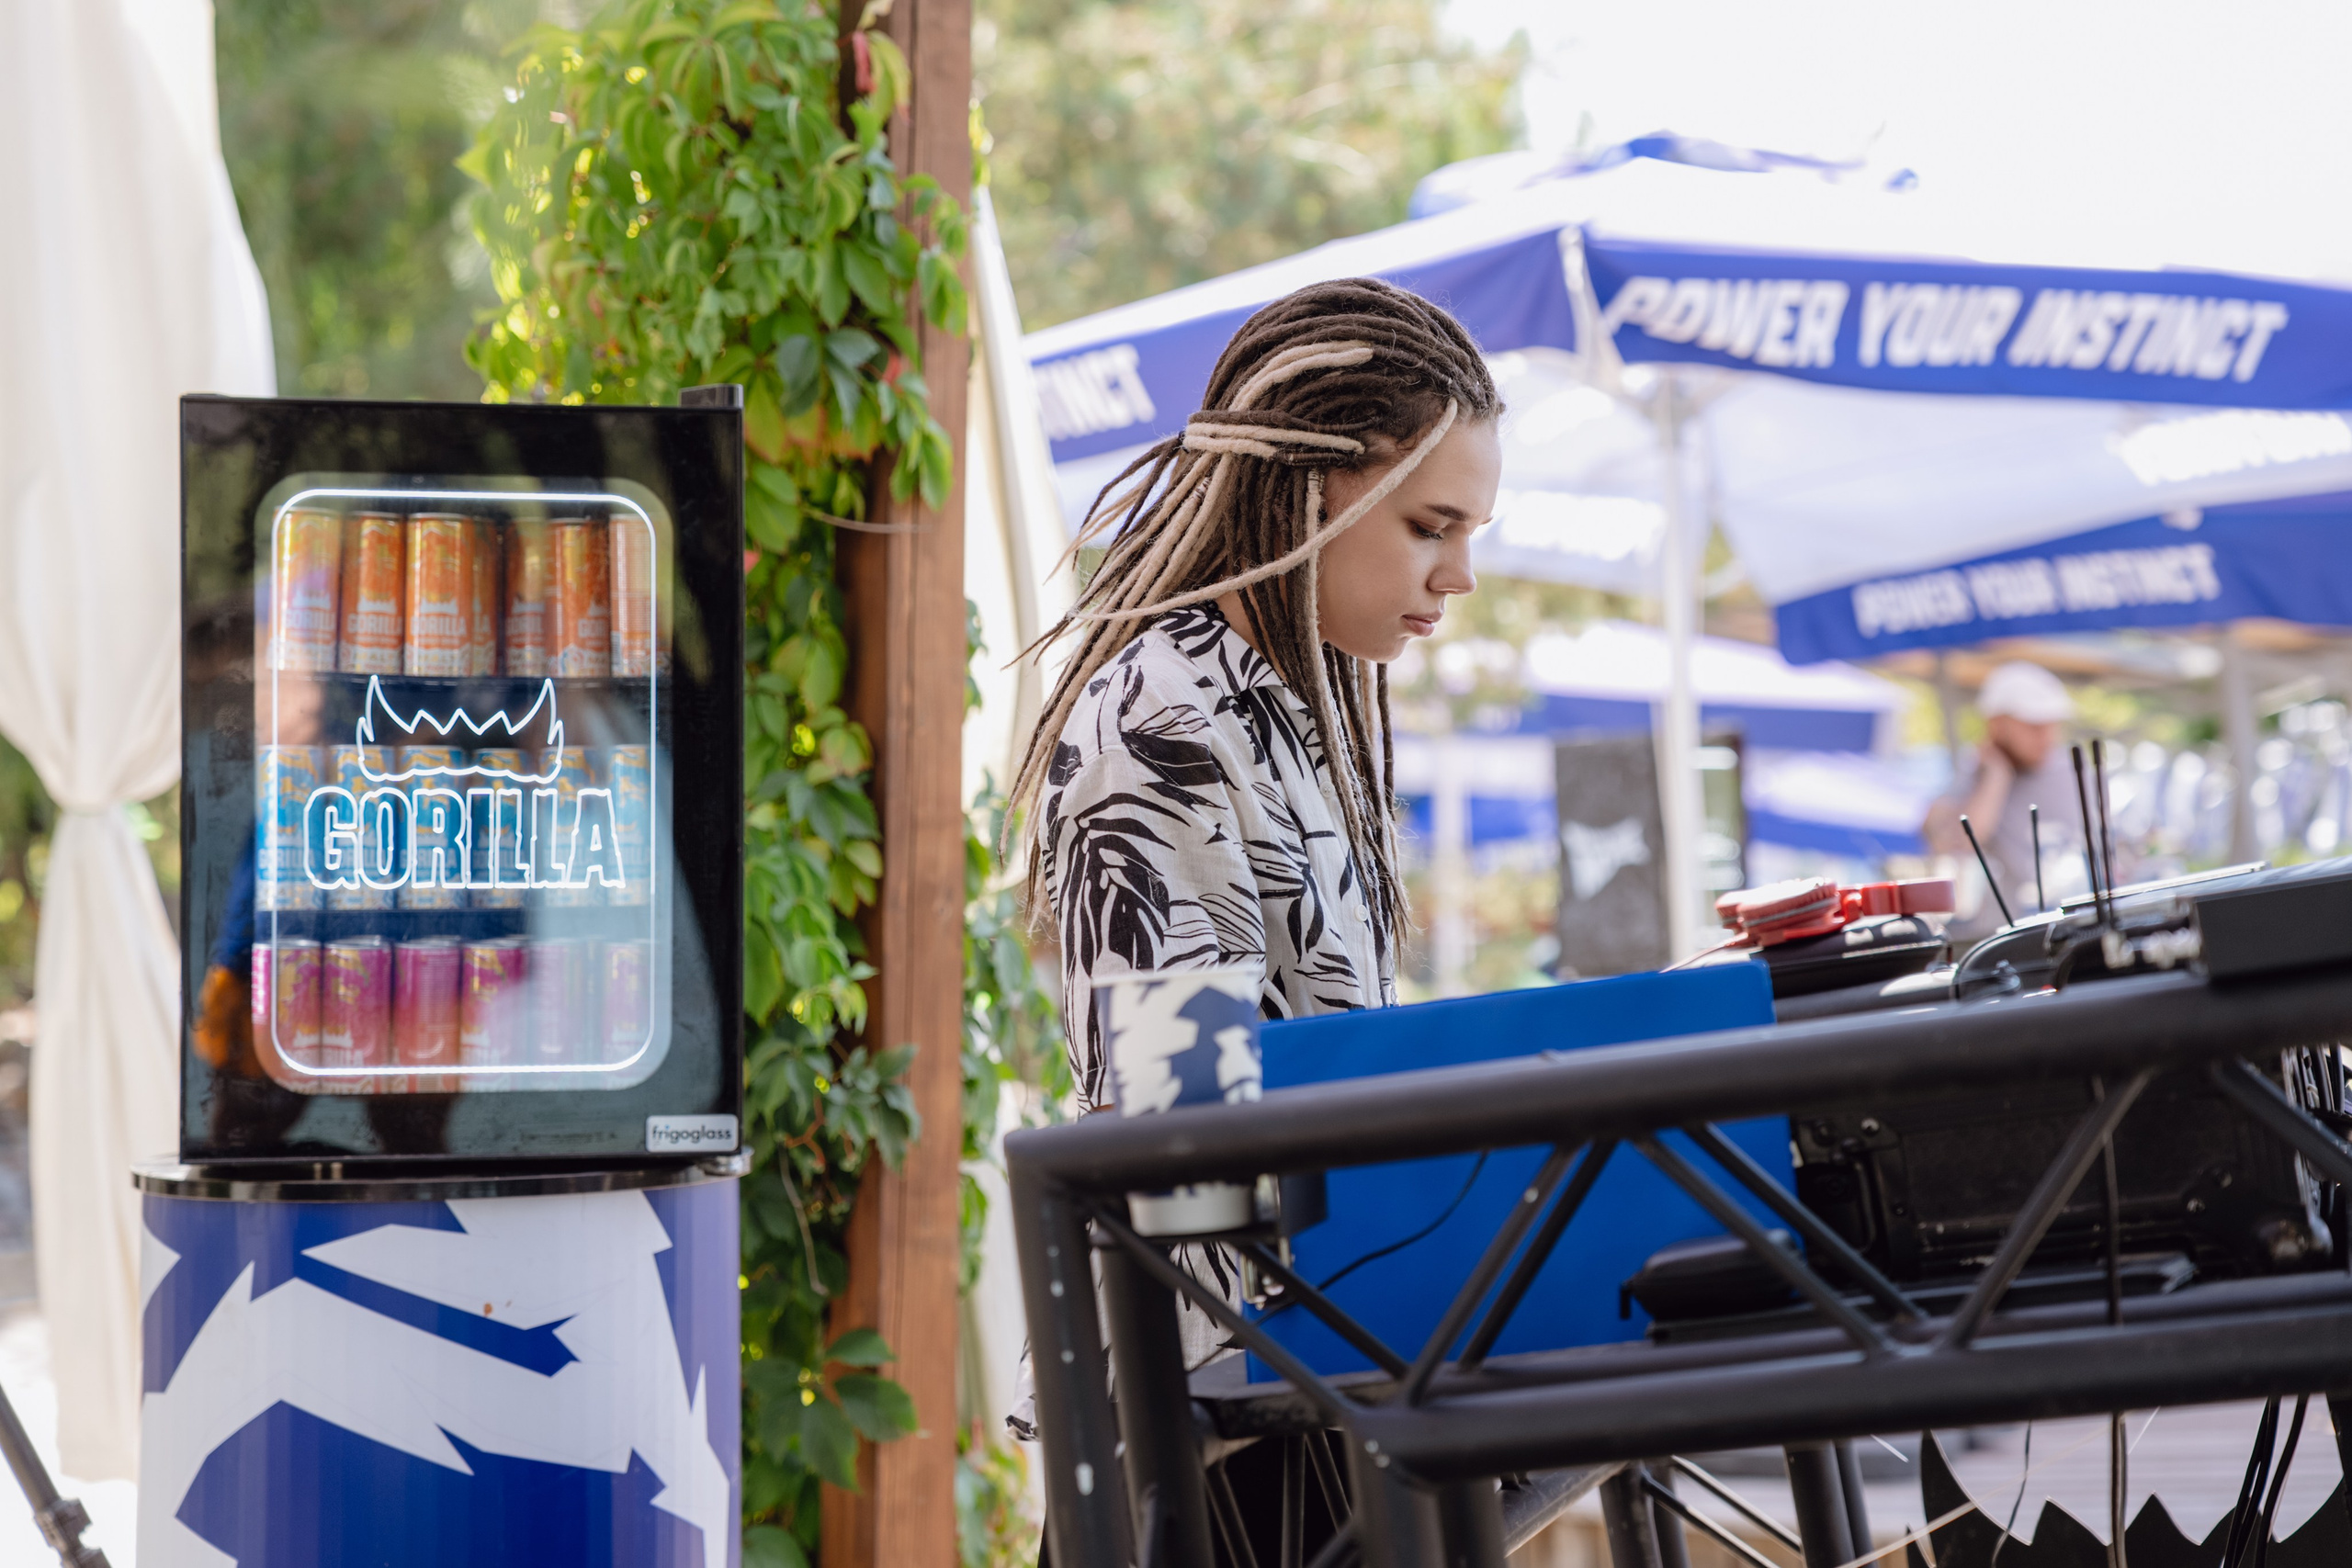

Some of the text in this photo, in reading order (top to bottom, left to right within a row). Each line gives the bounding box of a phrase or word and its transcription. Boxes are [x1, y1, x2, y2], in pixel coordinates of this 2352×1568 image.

[1605, 275, 2290, 383] POWER YOUR INSTINCT
[303, 786, 627, 891] GORILLA
[652, 1123, 732, 1145] frigoglass
